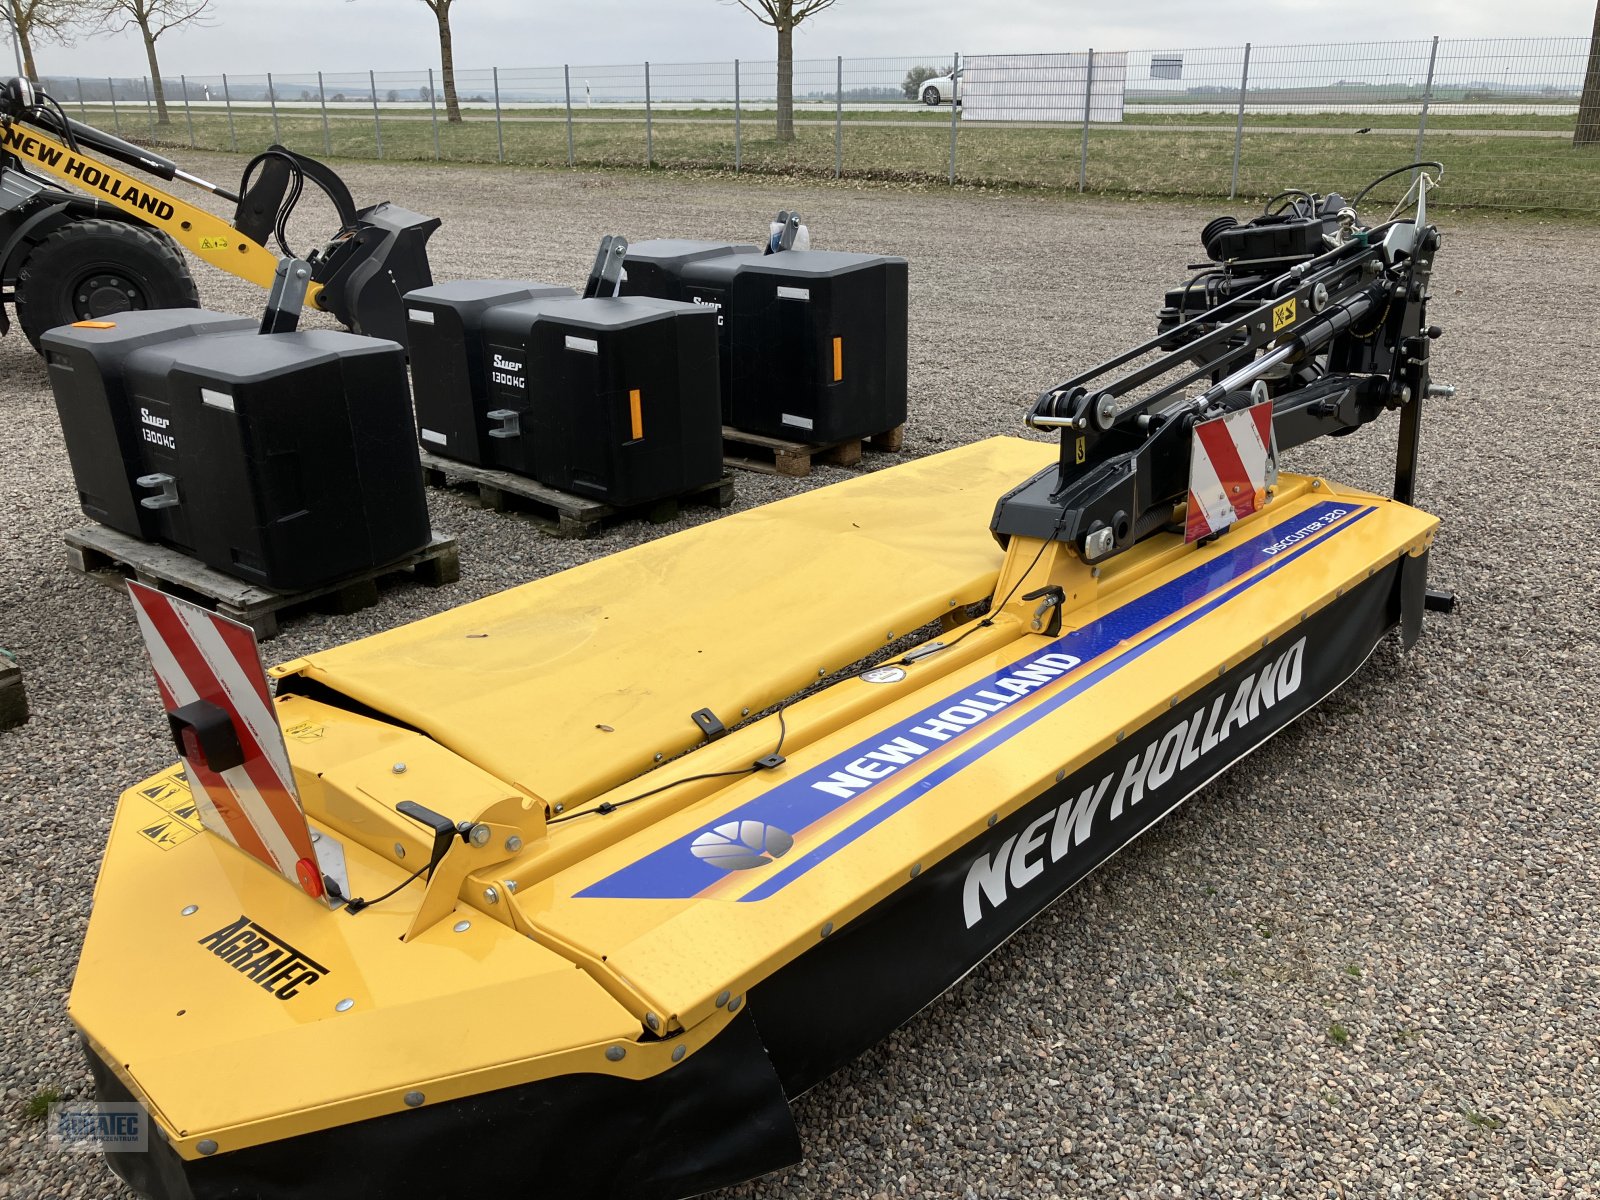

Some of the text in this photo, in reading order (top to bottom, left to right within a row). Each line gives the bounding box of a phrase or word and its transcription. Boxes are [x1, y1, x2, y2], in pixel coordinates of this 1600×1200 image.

[3, 129, 174, 221] NEW HOLLAND
[492, 371, 525, 389] 1300KG
[493, 353, 522, 371] Suer
[140, 407, 170, 429] Suer
[142, 428, 176, 450] 1300KG
[1262, 508, 1348, 555] DISCCUTTER 320
[811, 653, 1081, 799] NEW HOLLAND
[963, 636, 1307, 929] NEW HOLLAND
[197, 914, 331, 1001] AGRATEC
